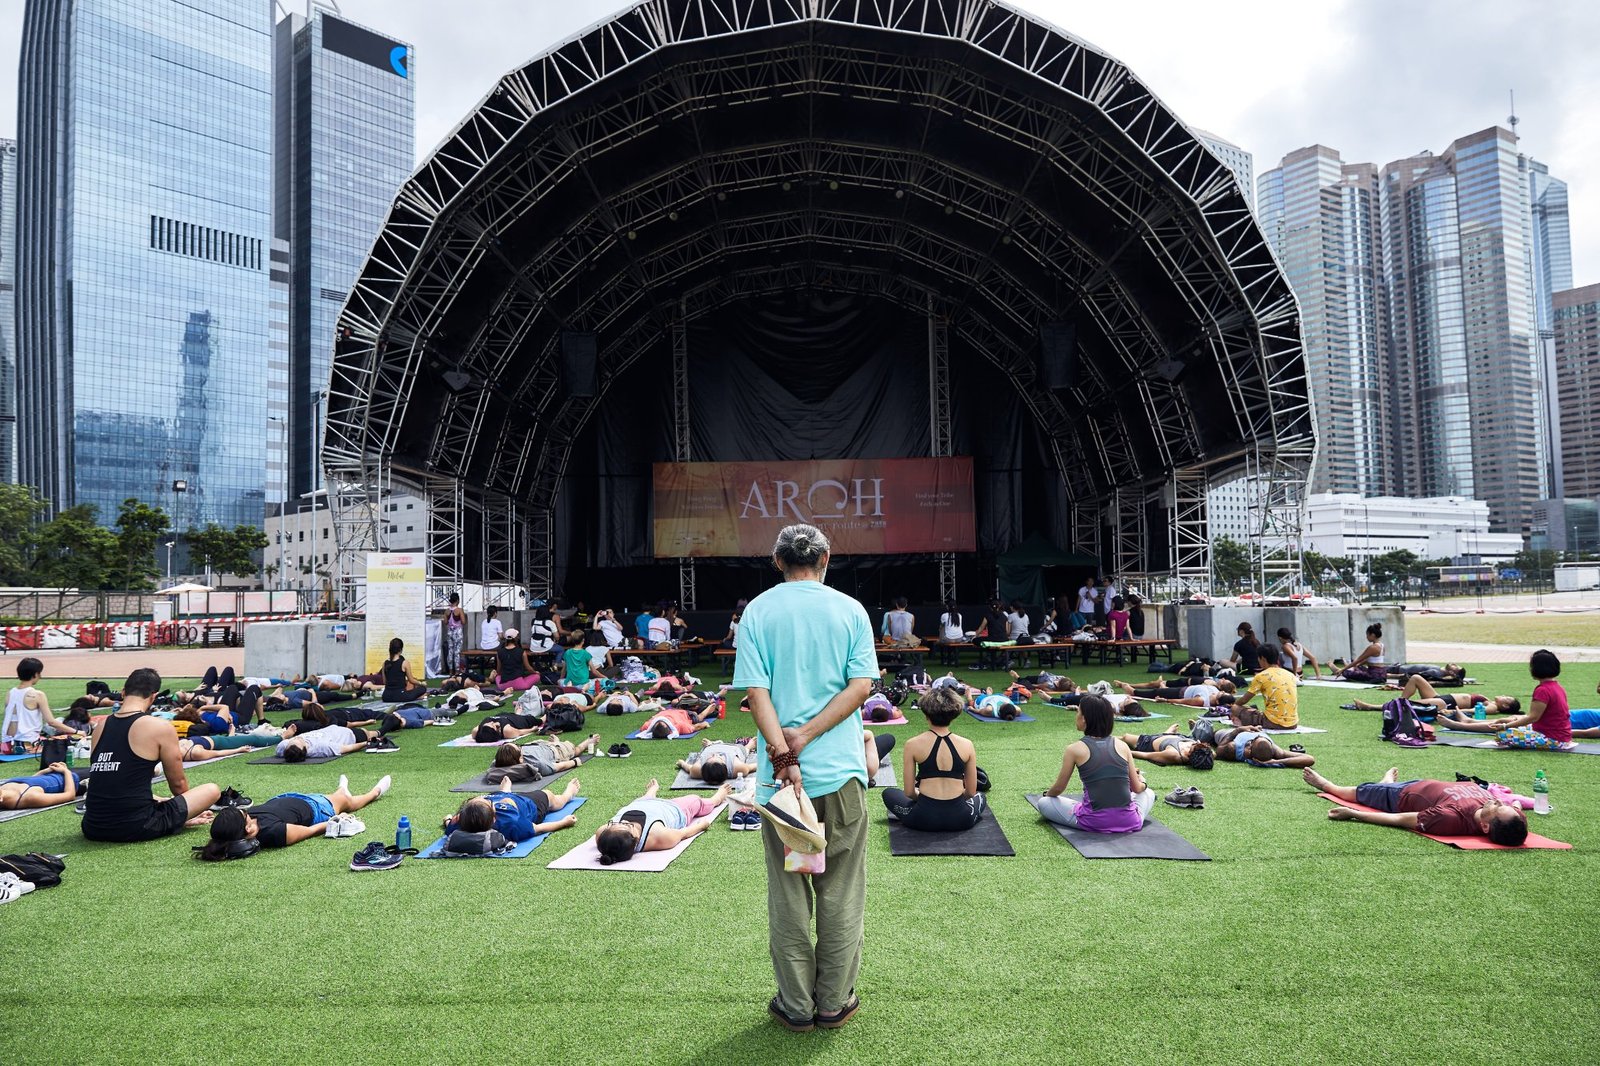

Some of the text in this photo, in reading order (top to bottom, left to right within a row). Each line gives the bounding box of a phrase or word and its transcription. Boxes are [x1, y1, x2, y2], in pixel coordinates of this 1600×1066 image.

[739, 478, 886, 523] ARCH
[98, 752, 114, 762] BUT
[90, 761, 121, 772] IFFERENT
